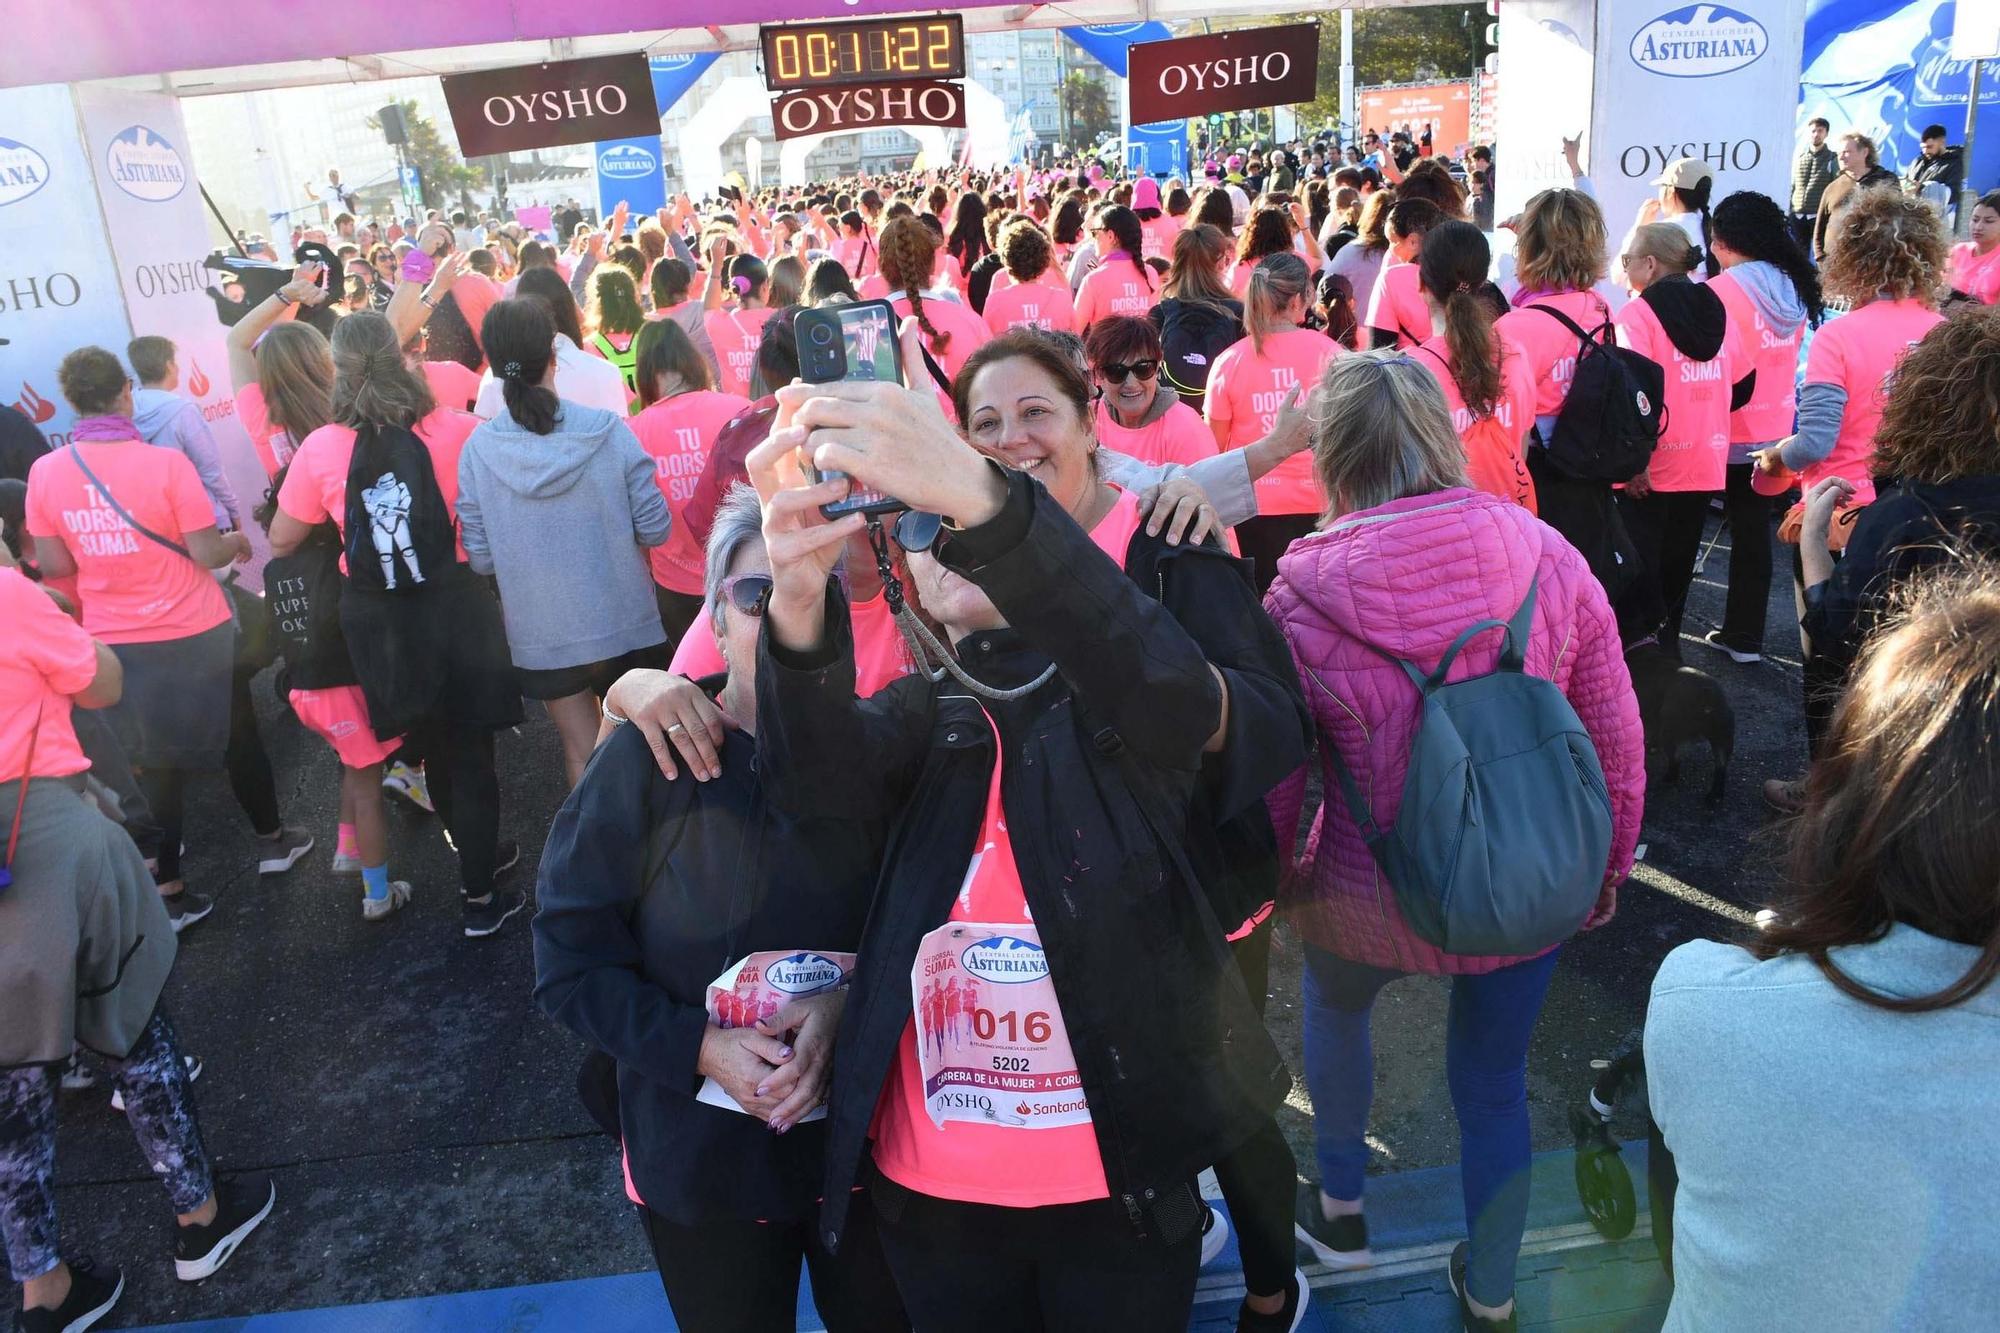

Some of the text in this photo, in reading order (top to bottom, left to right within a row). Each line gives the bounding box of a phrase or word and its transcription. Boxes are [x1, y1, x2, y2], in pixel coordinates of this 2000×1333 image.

[775, 24, 950, 79] 00:11:22
[1640, 33, 1757, 61] ASTURIANA
[1159, 51, 1291, 95] OYSHO
[483, 84, 627, 126] OYSHO
[781, 87, 957, 132] OYSHO
[117, 152, 183, 182] ASTURIANA
[1620, 138, 1762, 178] OYSHO
[136, 260, 210, 298] OYSHO
[1122, 282, 1138, 297] TU
[1022, 303, 1039, 318] TU
[1680, 361, 1722, 383] SUMA
[674, 427, 701, 451] TU
[79, 531, 140, 556] SUMA
[924, 958, 957, 977] SUMA
[968, 951, 1048, 973] ASTURIANA
[772, 967, 836, 984] ASTURIANA
[972, 1008, 1052, 1044] 016
[992, 1056, 1030, 1072] 5202
[937, 1071, 972, 1086] CARRERA
[974, 1073, 986, 1084] DE
[988, 1076, 999, 1086] LA
[1001, 1077, 1035, 1089] MUJER
[1044, 1077, 1052, 1087] A
[936, 1093, 992, 1112] OYSHO
